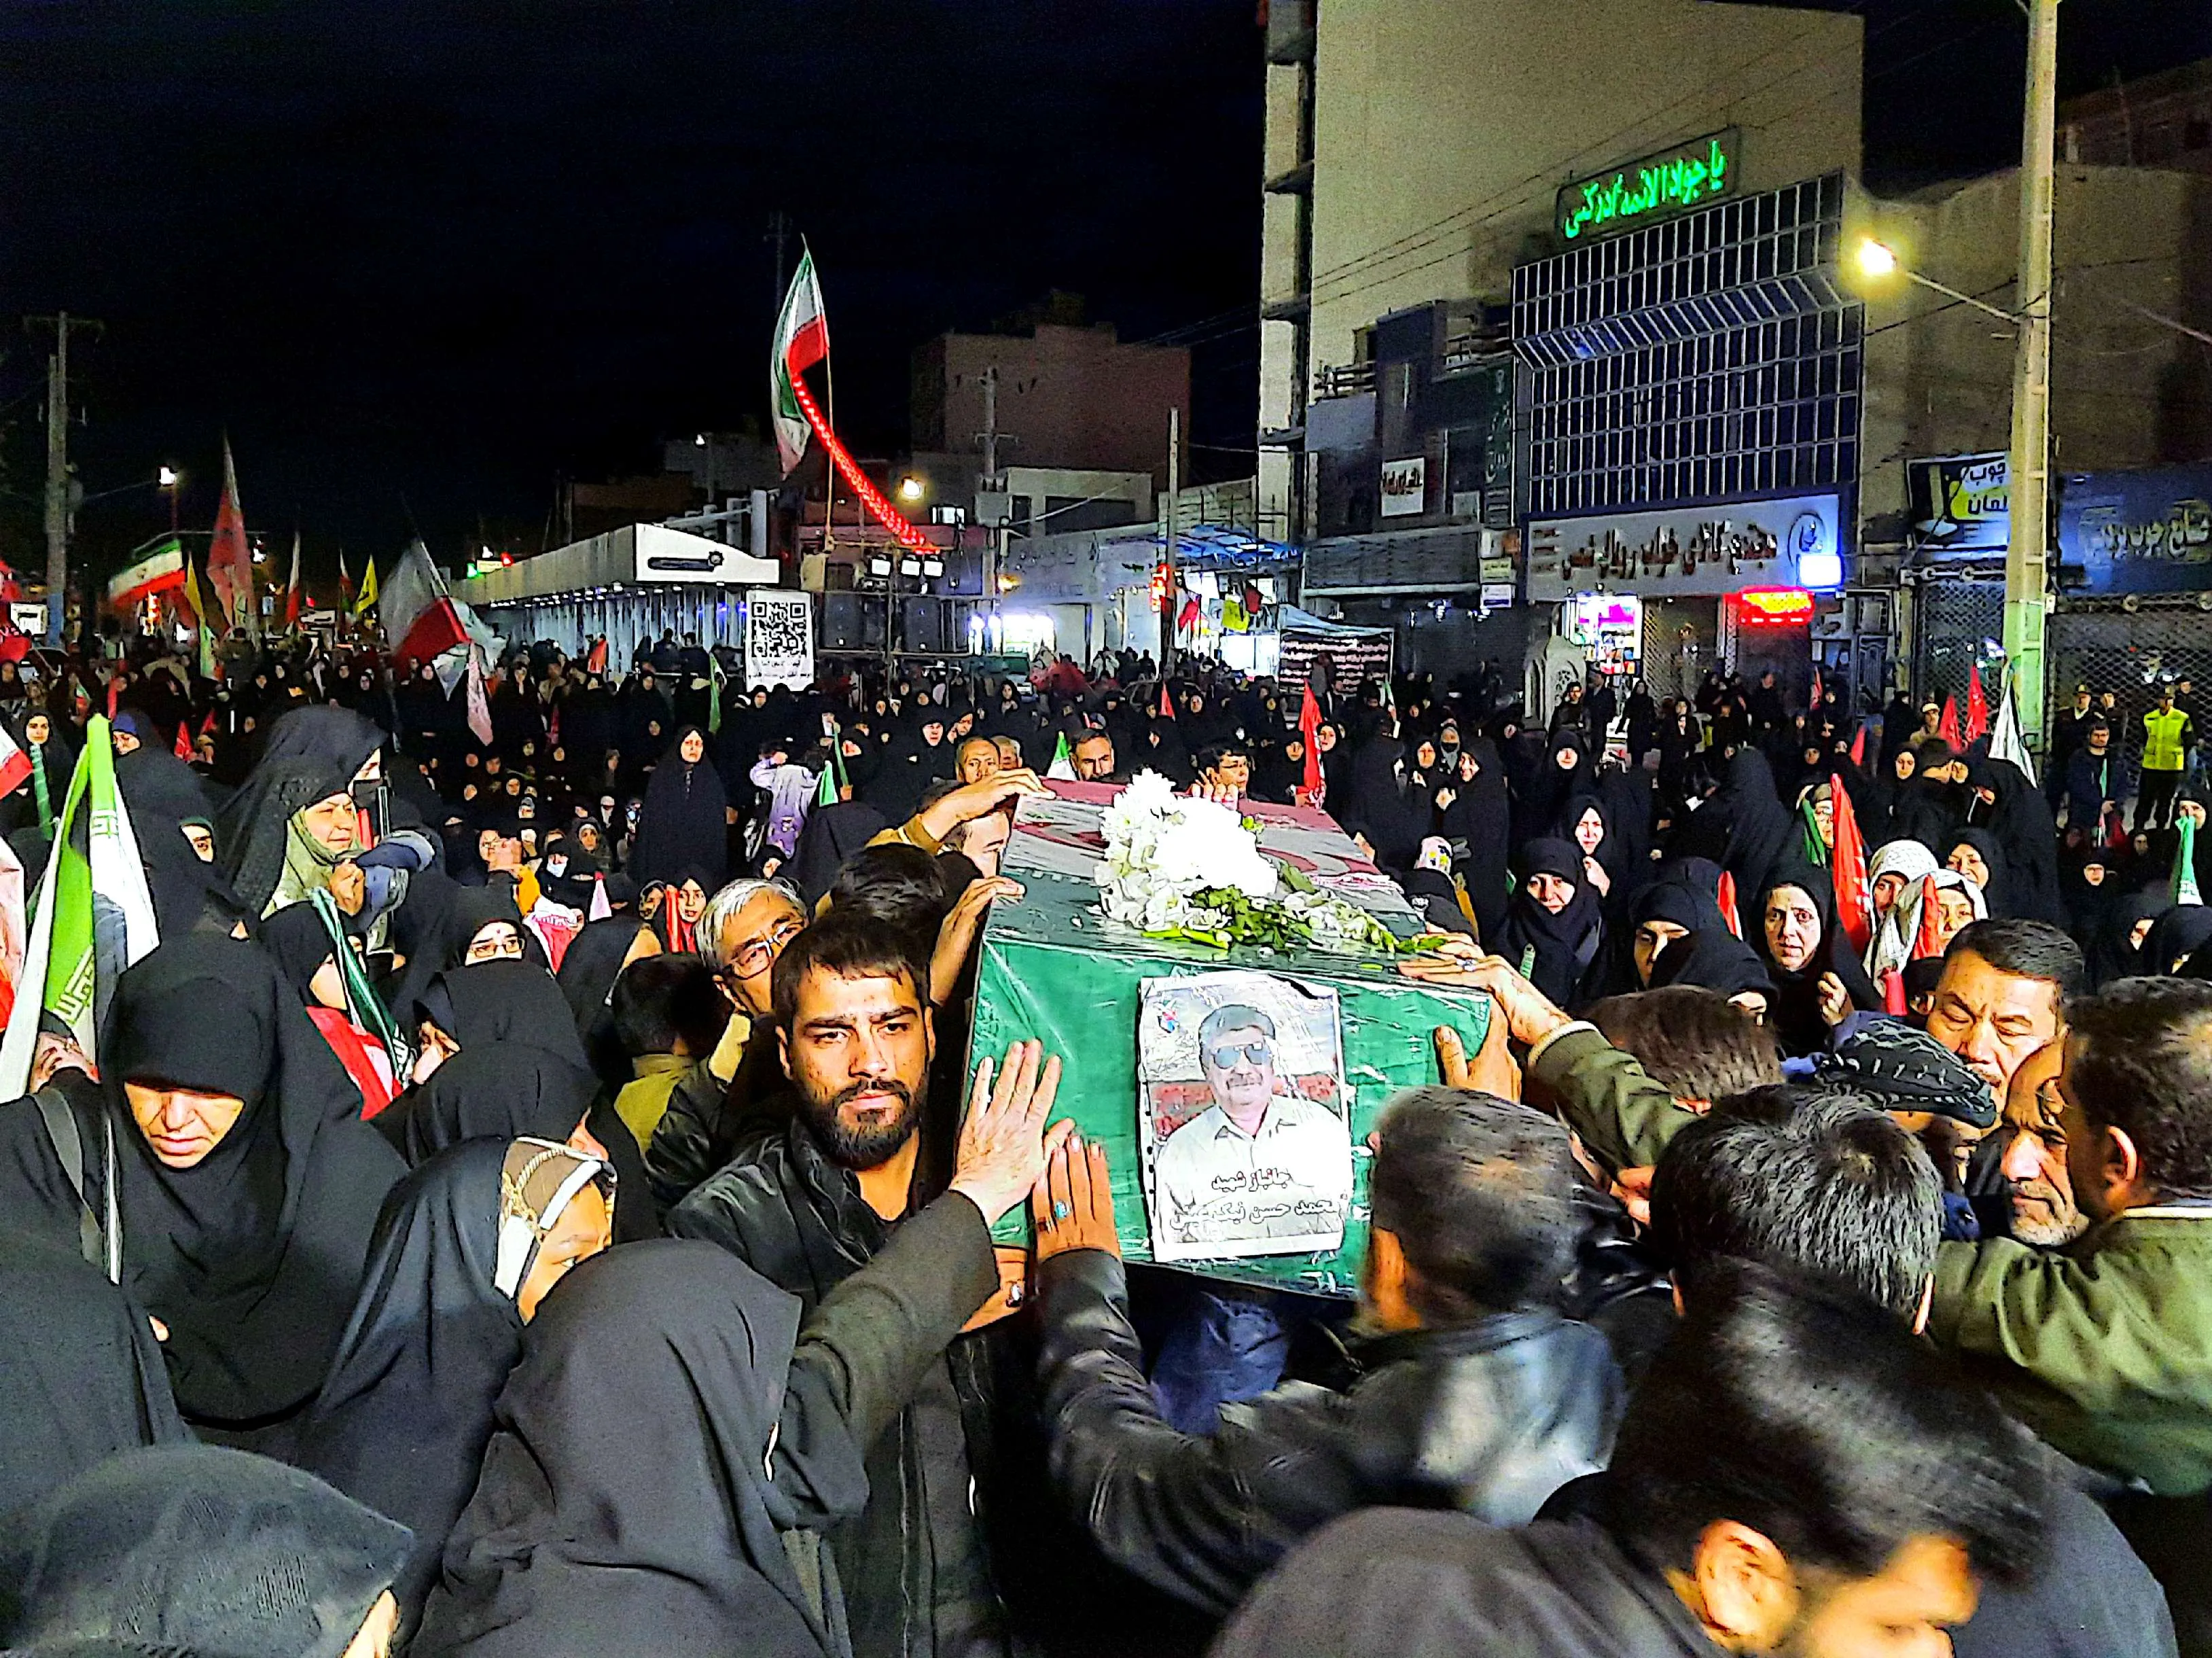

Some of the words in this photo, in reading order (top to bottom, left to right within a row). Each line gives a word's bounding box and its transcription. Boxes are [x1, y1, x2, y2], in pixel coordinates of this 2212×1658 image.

[1710, 140, 1727, 191] یا
[1211, 1171, 1247, 1193] شهید
[1249, 1167, 1291, 1193] جانباز
[1249, 1203, 1291, 1224] حسن
[1294, 1198, 1340, 1216] محمد
